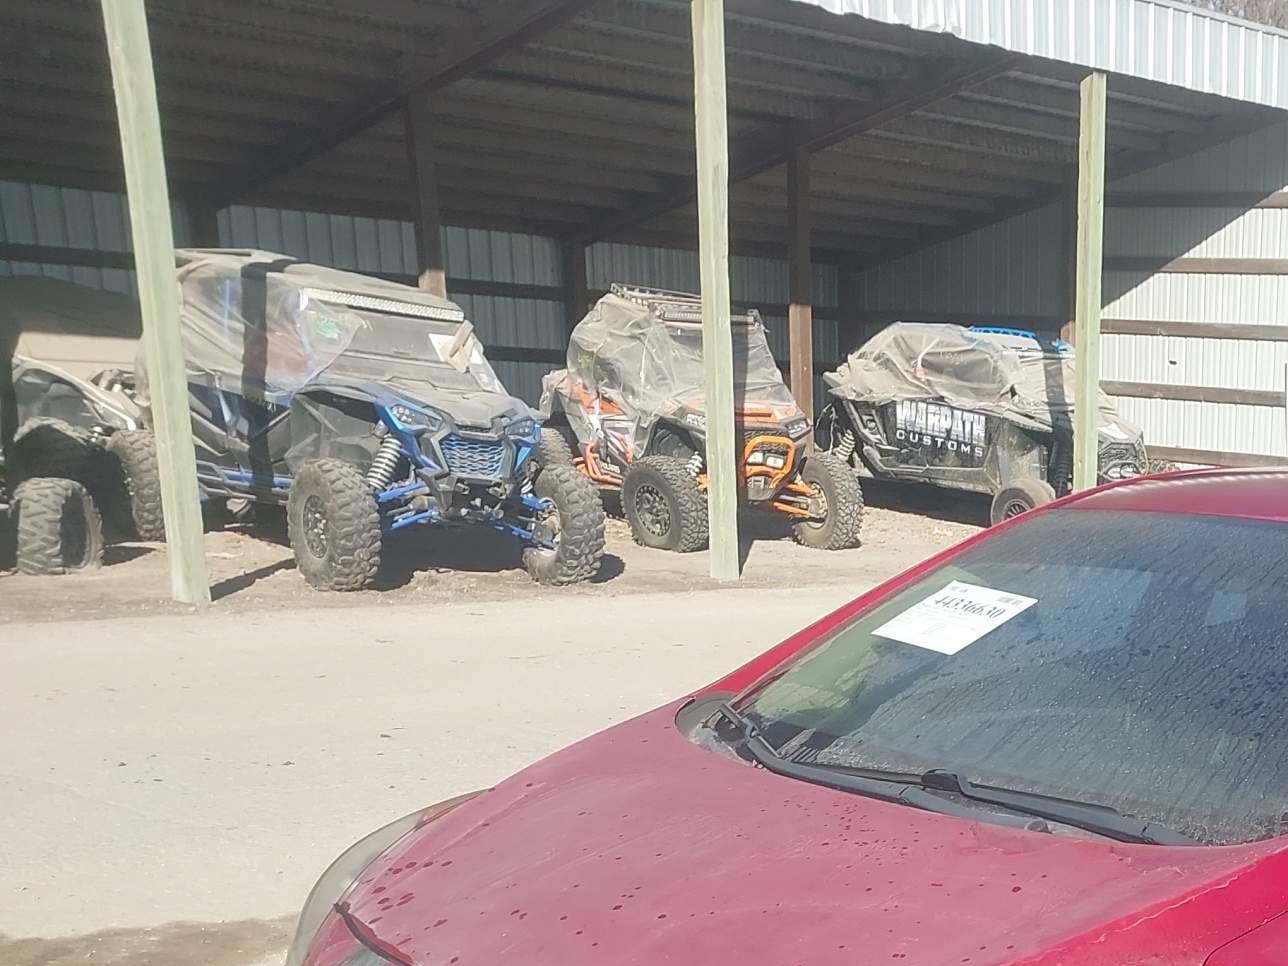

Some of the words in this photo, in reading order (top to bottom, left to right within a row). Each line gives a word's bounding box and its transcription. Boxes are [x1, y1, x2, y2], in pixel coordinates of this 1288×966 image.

[896, 400, 986, 447] WARPATH
[896, 429, 984, 457] CUSTOMS
[935, 595, 1006, 619] 44336630
